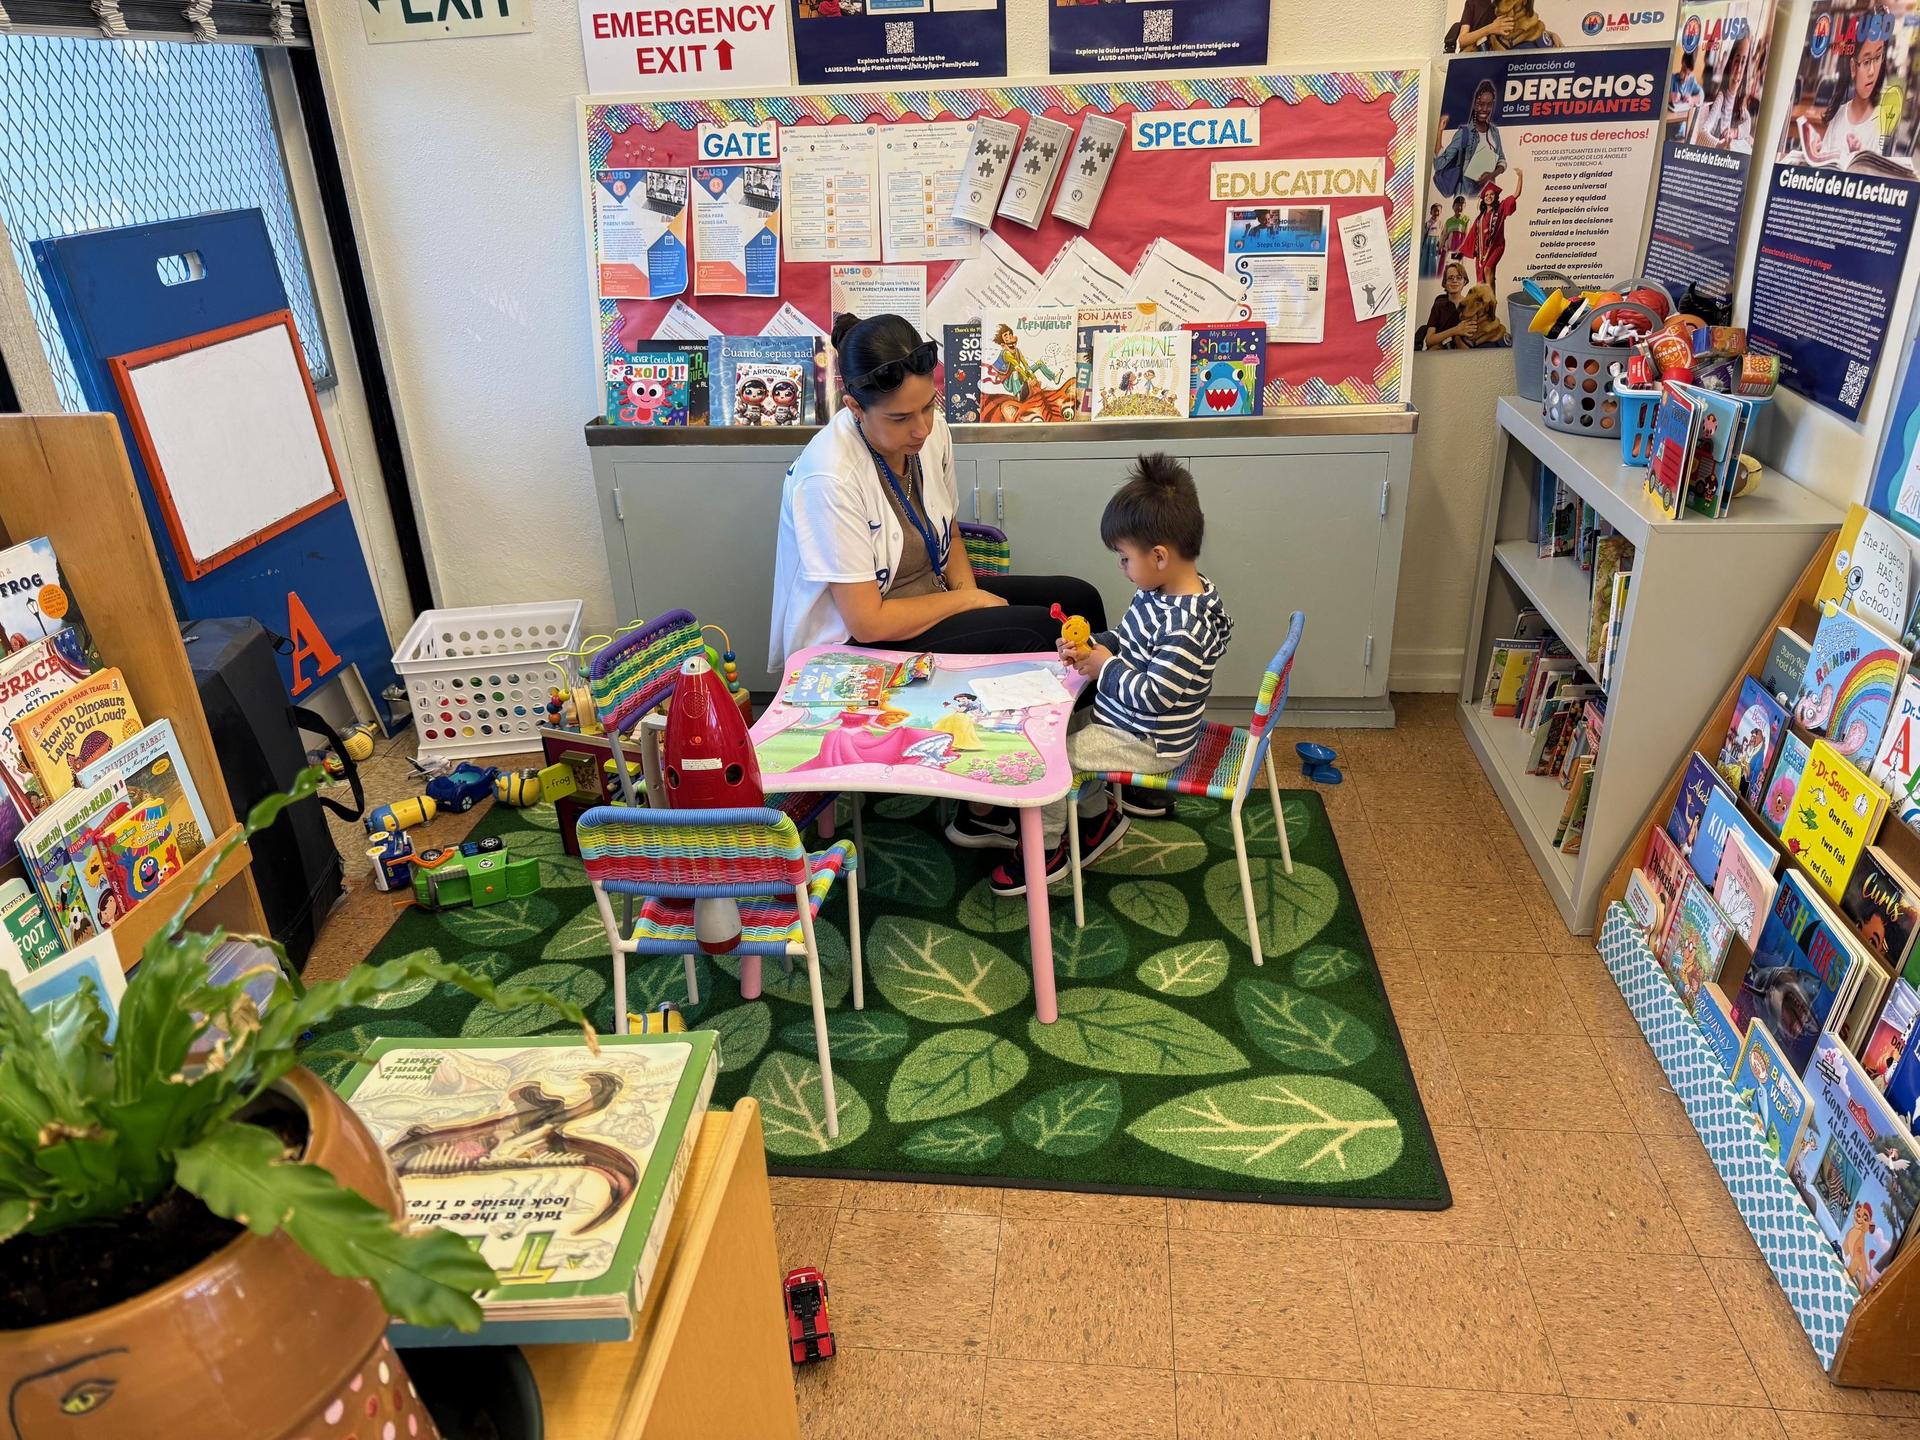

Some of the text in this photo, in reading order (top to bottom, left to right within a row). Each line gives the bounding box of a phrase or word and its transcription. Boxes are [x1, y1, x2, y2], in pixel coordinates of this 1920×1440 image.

[592, 5, 775, 39] EMERGENCY
[1606, 25, 1629, 33] UNIFIED
[1607, 11, 1664, 26] LAUSD
[1703, 16, 1749, 42] LAUSD
[1836, 14, 1895, 46] LAUSD
[636, 44, 707, 75] EXIT
[1508, 60, 1576, 72] Declaración de
[1503, 73, 1655, 102] DERECHOS
[1502, 97, 1653, 117] de los ESTUDIANTES
[1137, 118, 1253, 148] SPECIAL
[1519, 128, 1649, 146] ¡Conoce tus derechos!
[703, 132, 771, 158] GATE
[1674, 147, 1740, 171] La Ciencia de la Escritura
[1215, 168, 1378, 199] EDUCATION
[1542, 170, 1613, 181] Respeto y dignidad
[1572, 182, 1608, 190] universal
[1569, 195, 1575, 203] y
[1575, 194, 1607, 203] equidad
[1779, 168, 1908, 207] Ciencia de la Lectura
[1536, 205, 1585, 215] Participación
[1530, 229, 1569, 237] Diversidad
[1575, 228, 1609, 236] inclusión
[1535, 251, 1597, 259] Confidencialidad
[1567, 261, 1603, 270] expresión
[833, 267, 861, 275] LAUSD
[1101, 311, 1133, 321] JAMES
[1199, 337, 1247, 354] Shark
[1209, 330, 1220, 338] My
[721, 347, 762, 358] Cuando
[765, 350, 791, 361] sepas
[1121, 336, 1145, 357] AM
[1151, 335, 1177, 357] WE
[631, 355, 649, 363] NEVER
[649, 353, 676, 364] touch
[624, 365, 685, 380] axolotl!
[753, 368, 788, 376] ARMOONIA
[1862, 531, 1905, 574] The Pigeon
[1876, 562, 1903, 592] HAS to
[1859, 589, 1899, 624] School!
[1878, 582, 1902, 608] Go to
[287, 591, 342, 696] A
[1815, 647, 1860, 686] RAINBOW!
[0, 655, 61, 704] GRACE
[24, 687, 42, 701] FOR
[39, 715, 51, 729] JANE
[52, 701, 68, 717] YOLEN
[73, 690, 88, 701] MARK
[89, 683, 111, 693] TEAGUE
[1901, 698, 1916, 718] Dr.
[40, 725, 61, 754] How
[59, 715, 76, 731] Do
[75, 696, 125, 719] Dinosaurs
[47, 708, 127, 765] Laugh Out Loud?
[1882, 716, 1912, 777] A
[551, 775, 570, 787] frog
[1812, 759, 1818, 769] By
[1816, 760, 1829, 781] Dr.
[1828, 770, 1850, 802] Seuss
[1828, 808, 1854, 838] One fish
[1820, 836, 1846, 866] two fish
[1649, 849, 1677, 900] Pinocchio
[1809, 859, 1833, 887] red fish
[1862, 872, 1904, 922] Curls
[1698, 999, 1733, 1050] RUNAWAY
[383, 1065, 438, 1074] Dennis
[395, 1057, 443, 1065] Schatz
[1770, 1085, 1791, 1124] World
[435, 1200, 446, 1209] T.
[471, 1199, 524, 1210] inside
[531, 1196, 570, 1207] look
